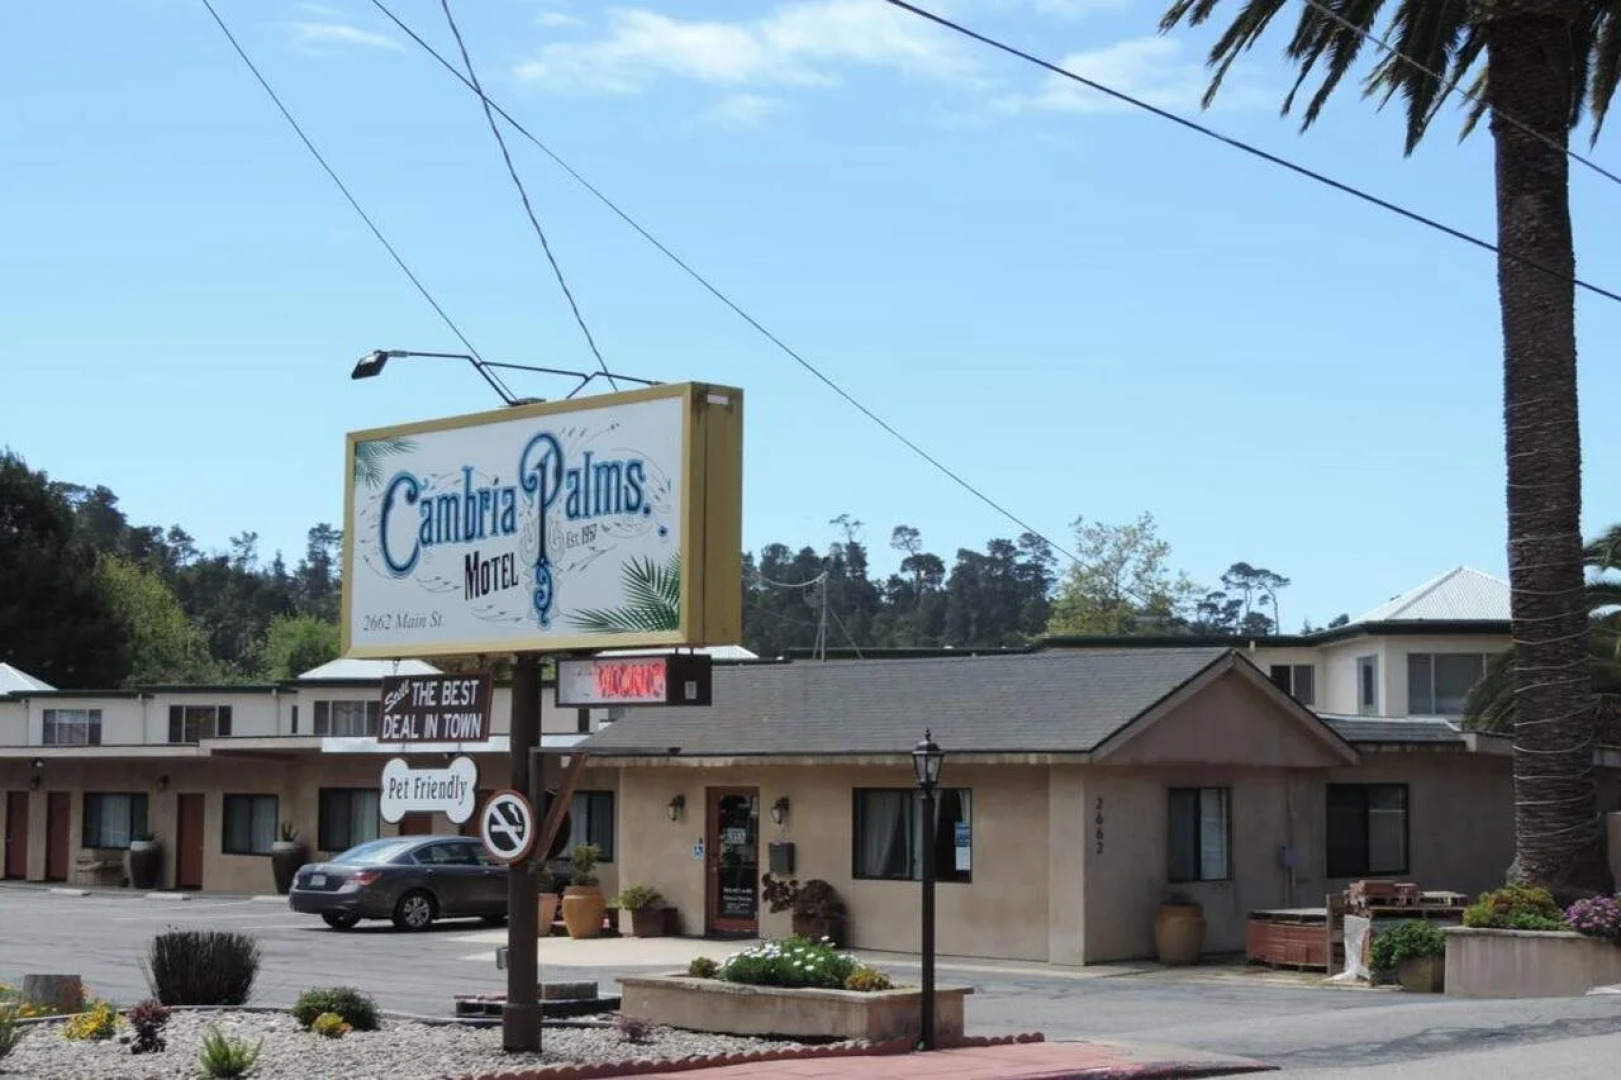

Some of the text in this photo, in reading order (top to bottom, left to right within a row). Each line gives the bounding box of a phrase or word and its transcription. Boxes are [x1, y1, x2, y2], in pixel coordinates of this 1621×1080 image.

[380, 464, 517, 577] Cambria
[396, 612, 427, 629] Main
[412, 681, 438, 707] THE
[441, 680, 480, 706] BEST
[382, 712, 482, 739] DEAL IN TOWN
[388, 775, 467, 806] Pet Friendly
[1094, 796, 1105, 855] 2662
